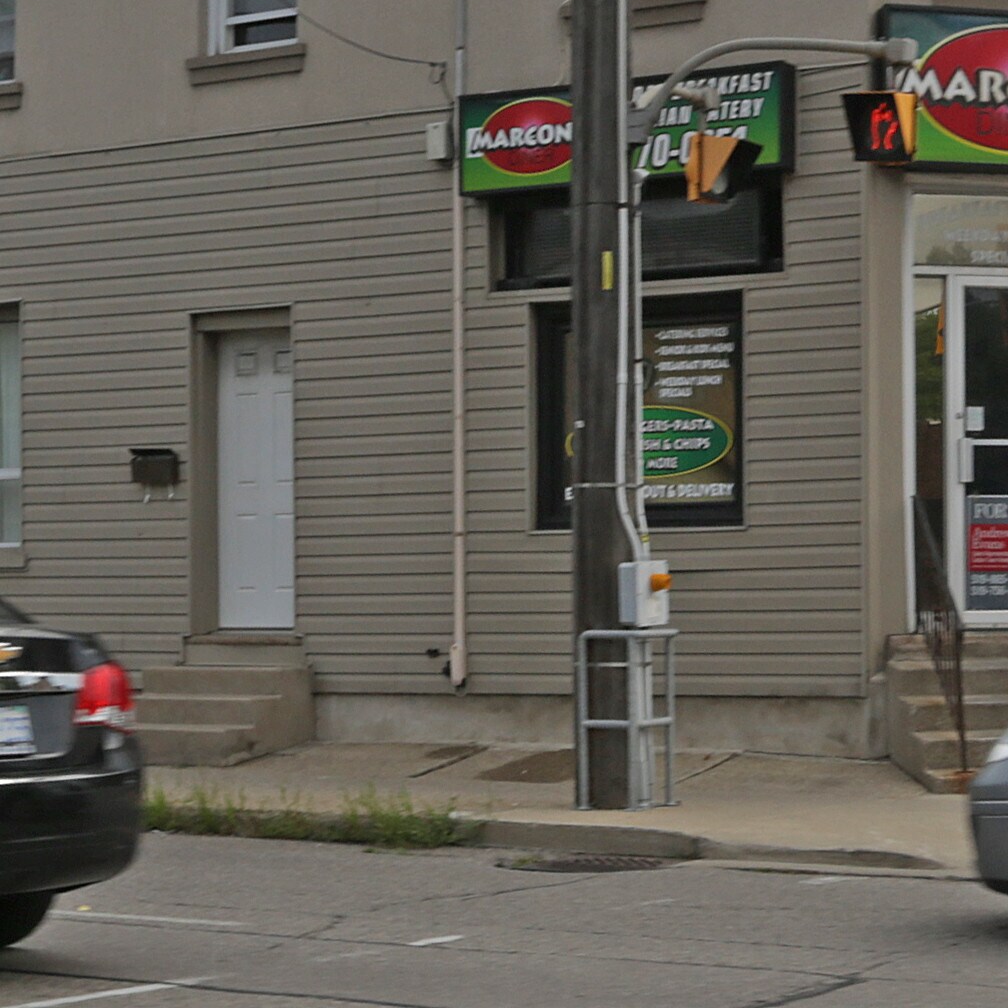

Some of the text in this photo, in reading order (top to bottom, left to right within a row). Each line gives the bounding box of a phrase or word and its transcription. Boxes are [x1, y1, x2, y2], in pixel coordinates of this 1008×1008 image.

[673, 437, 711, 450] CHIPS
[677, 482, 736, 498] DELIVERY
[973, 503, 1008, 519] FOR
